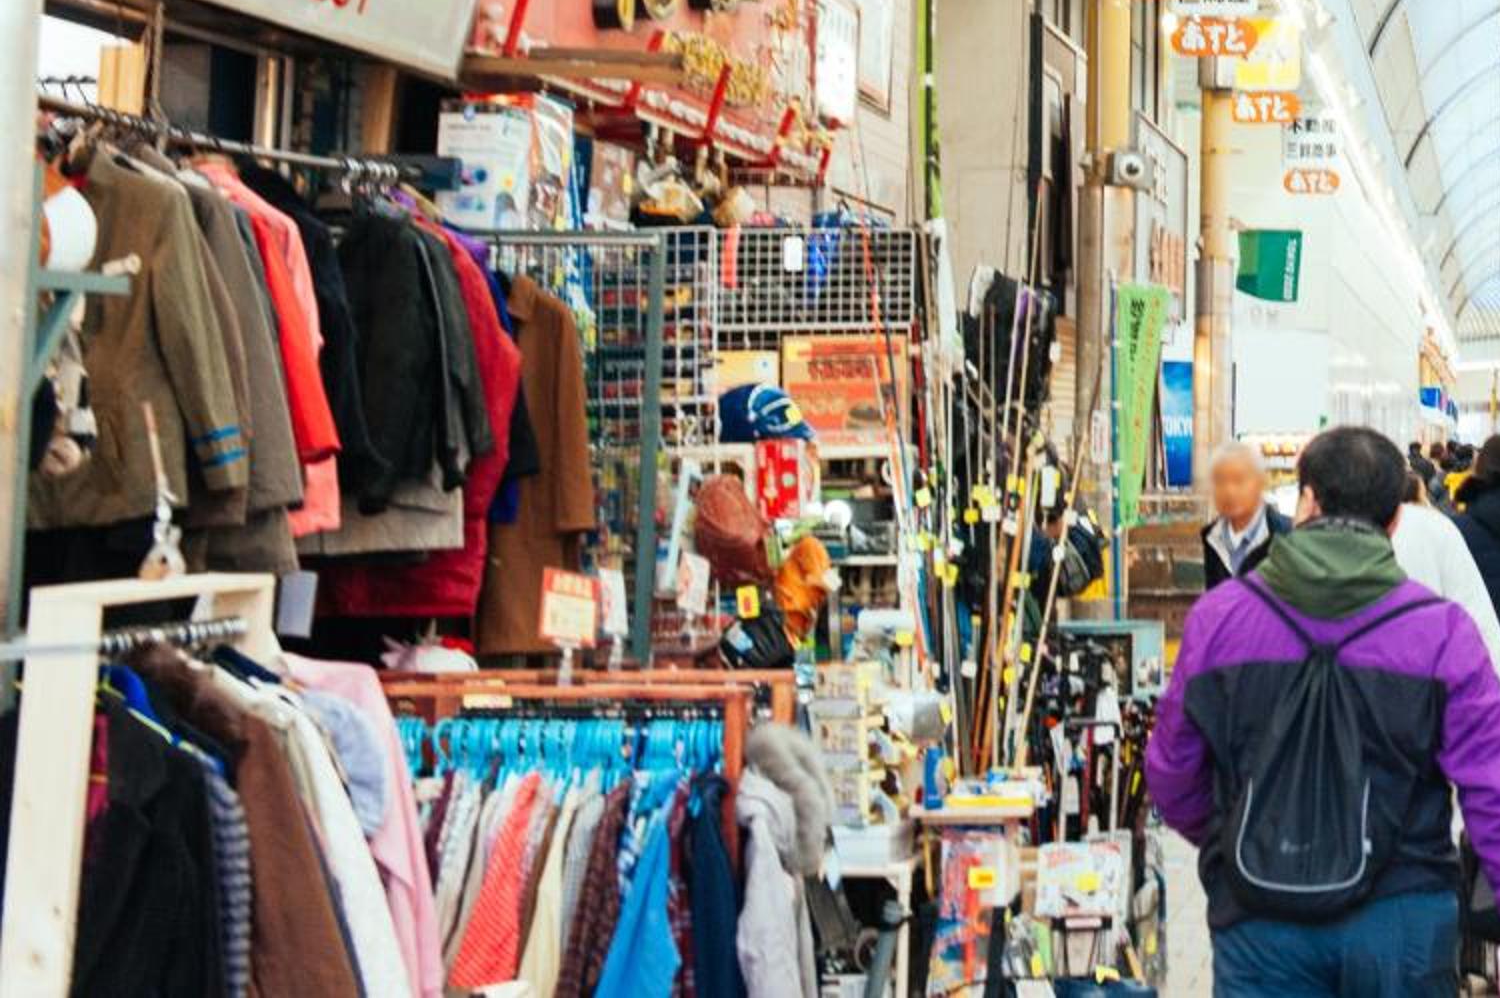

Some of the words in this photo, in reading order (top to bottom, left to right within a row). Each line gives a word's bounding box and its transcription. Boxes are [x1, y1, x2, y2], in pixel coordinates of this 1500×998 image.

[1181, 19, 1247, 52] あすと
[1235, 92, 1292, 121] あすと
